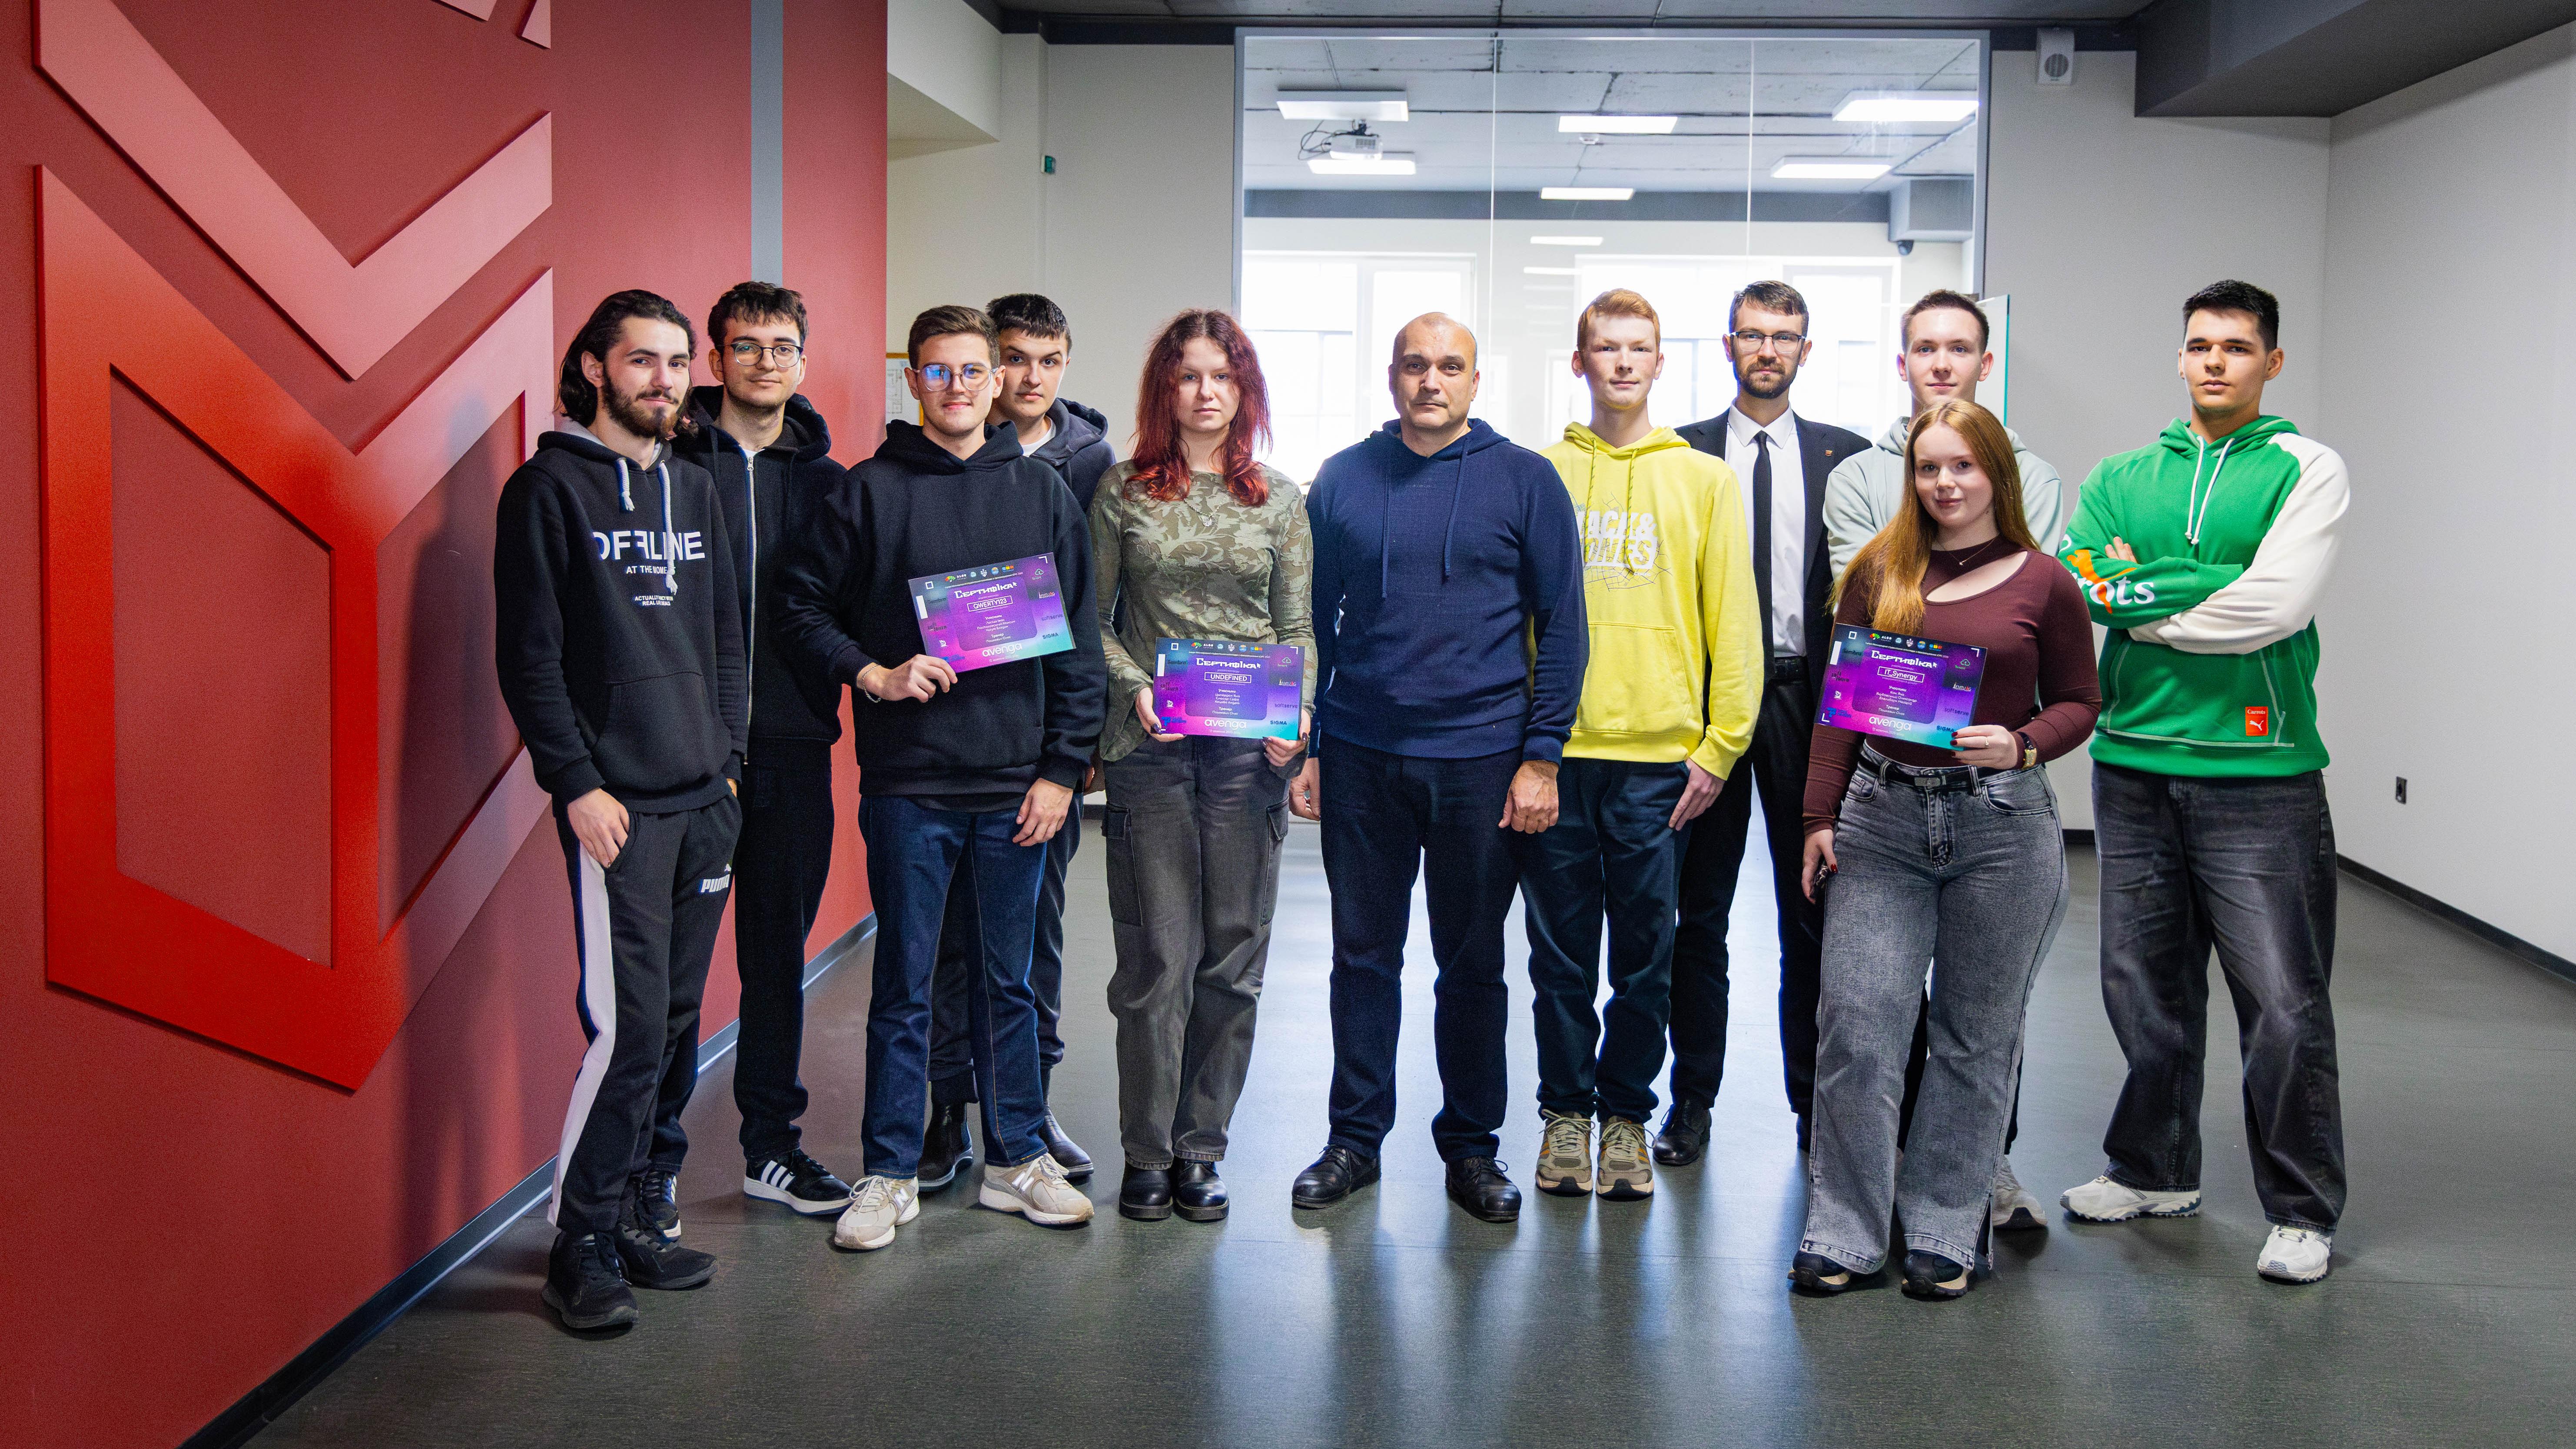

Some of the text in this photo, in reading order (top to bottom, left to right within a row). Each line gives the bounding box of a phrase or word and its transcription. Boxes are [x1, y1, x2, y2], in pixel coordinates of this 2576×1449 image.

[592, 531, 705, 560] OFFLINE
[973, 598, 1007, 609] QWERTY123
[982, 643, 1022, 657] avenga
[1884, 668, 1918, 680] IT_Synergy
[1205, 719, 1247, 730] avenga
[1869, 716, 1912, 731] avenga
[700, 874, 730, 893] PUMA
